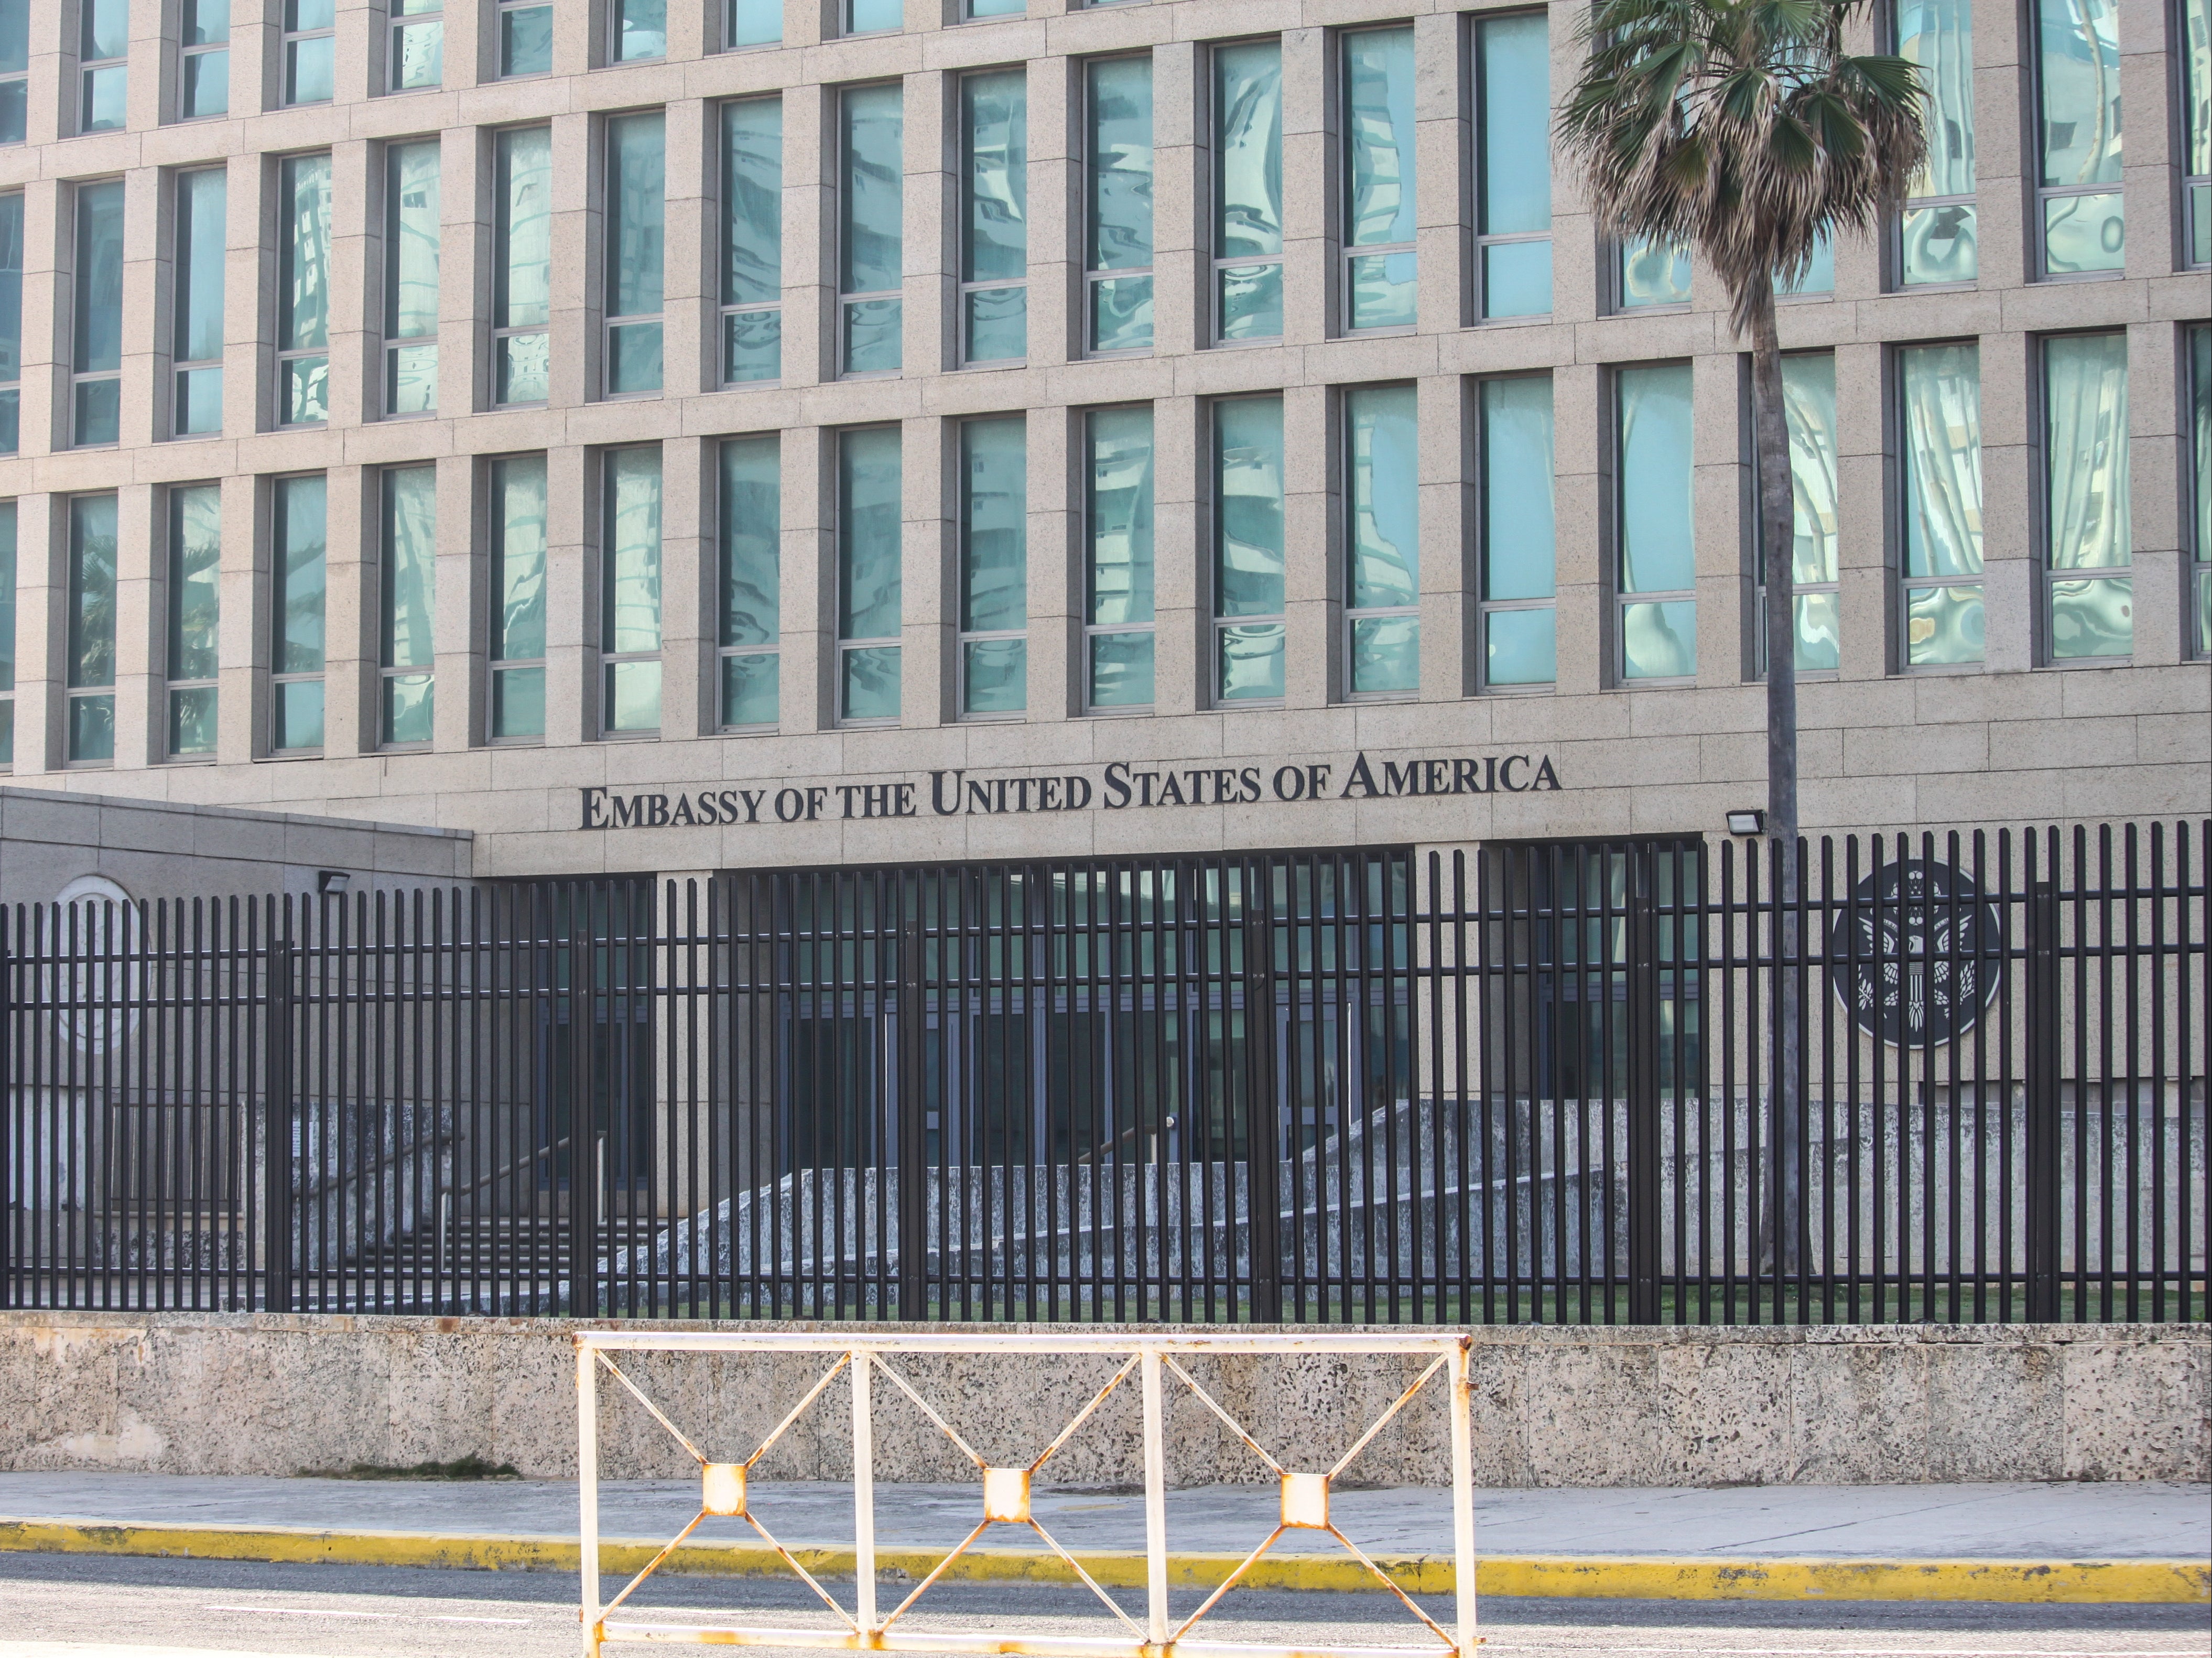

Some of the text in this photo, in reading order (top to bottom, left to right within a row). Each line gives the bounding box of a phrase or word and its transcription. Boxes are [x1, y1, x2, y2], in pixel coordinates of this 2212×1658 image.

[578, 750, 1564, 831] EMBASSY OF THE UNITED STATES OF AMERICA
